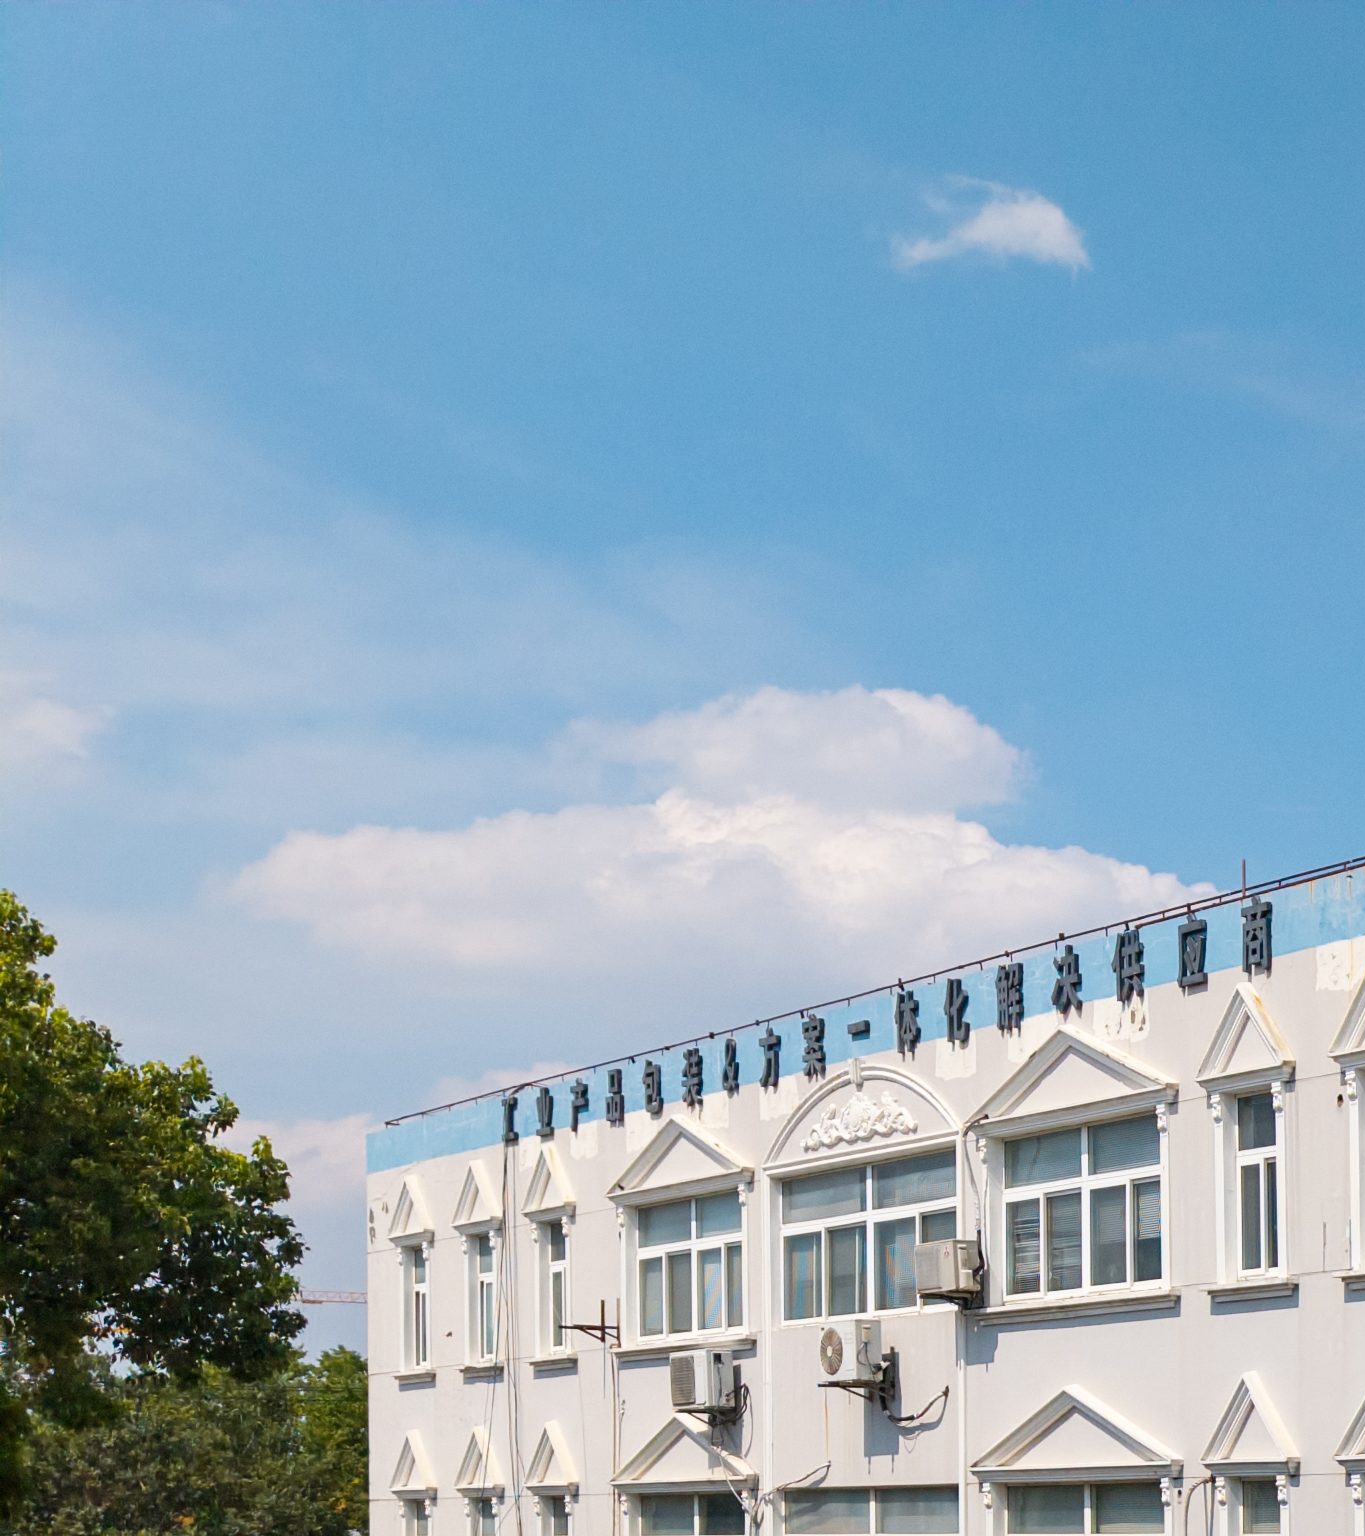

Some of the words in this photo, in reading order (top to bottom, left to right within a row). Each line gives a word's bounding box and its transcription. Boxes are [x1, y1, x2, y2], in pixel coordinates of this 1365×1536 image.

[501, 895, 1273, 1141] 工业产品包装&方案一体化解决供应商
